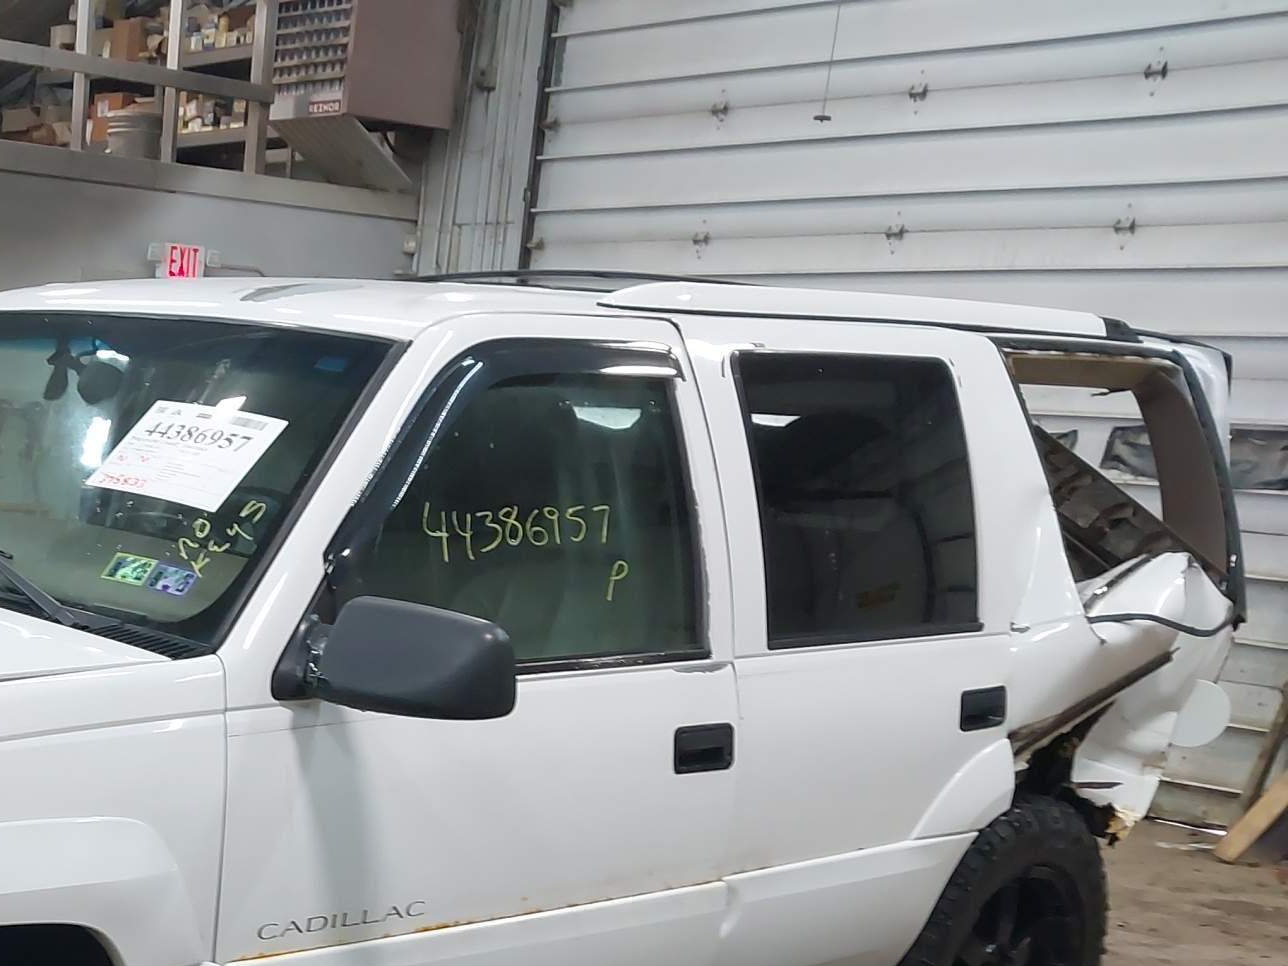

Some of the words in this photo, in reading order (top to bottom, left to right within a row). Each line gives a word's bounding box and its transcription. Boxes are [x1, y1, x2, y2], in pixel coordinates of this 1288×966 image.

[169, 245, 199, 277] EXIT
[145, 421, 253, 452] 44386957
[422, 501, 609, 562] 44386957
[257, 900, 426, 940] CADILLAC
